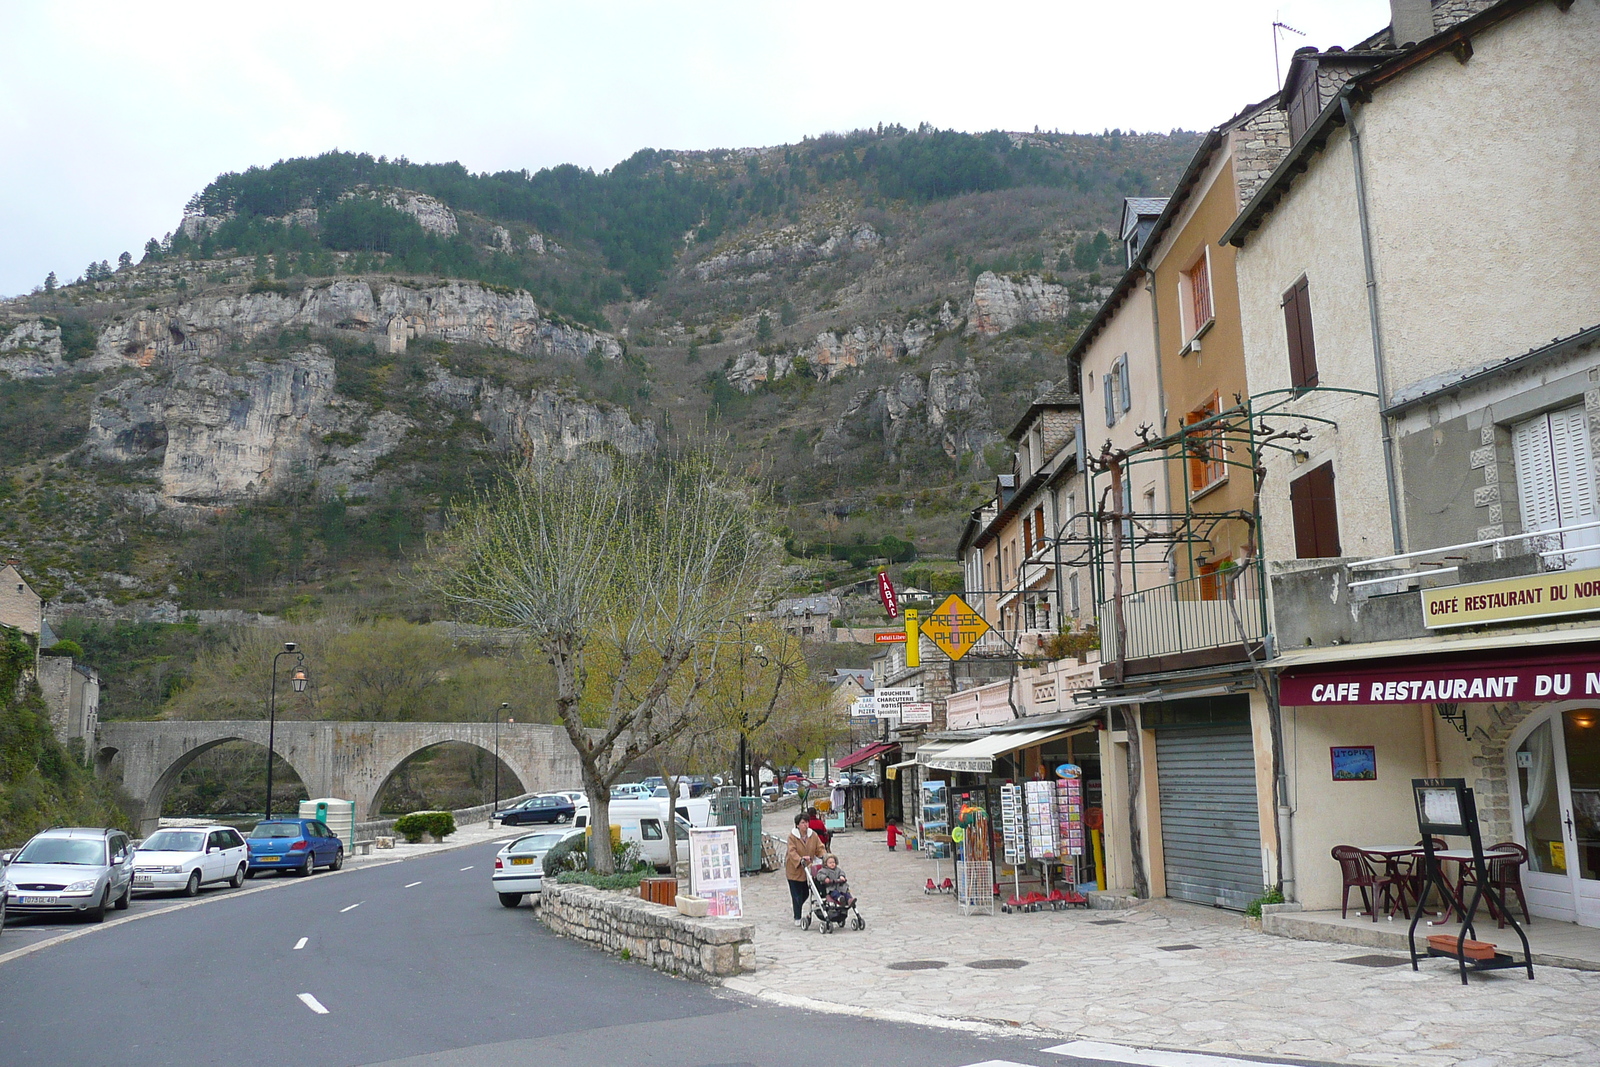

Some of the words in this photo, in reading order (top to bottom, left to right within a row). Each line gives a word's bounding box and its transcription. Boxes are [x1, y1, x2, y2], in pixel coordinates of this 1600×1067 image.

[880, 572, 897, 617] TABAC
[1430, 596, 1459, 616] CAFÉ
[1464, 587, 1543, 612] RESTAURANT
[1550, 584, 1568, 602] DU
[929, 613, 981, 627] PRESSE
[934, 631, 977, 645] PHOTO
[1311, 682, 1360, 703] CAFE
[1370, 675, 1519, 701] RESTAURANT
[1534, 673, 1572, 697] DU
[1423, 779, 1446, 787] MENU
